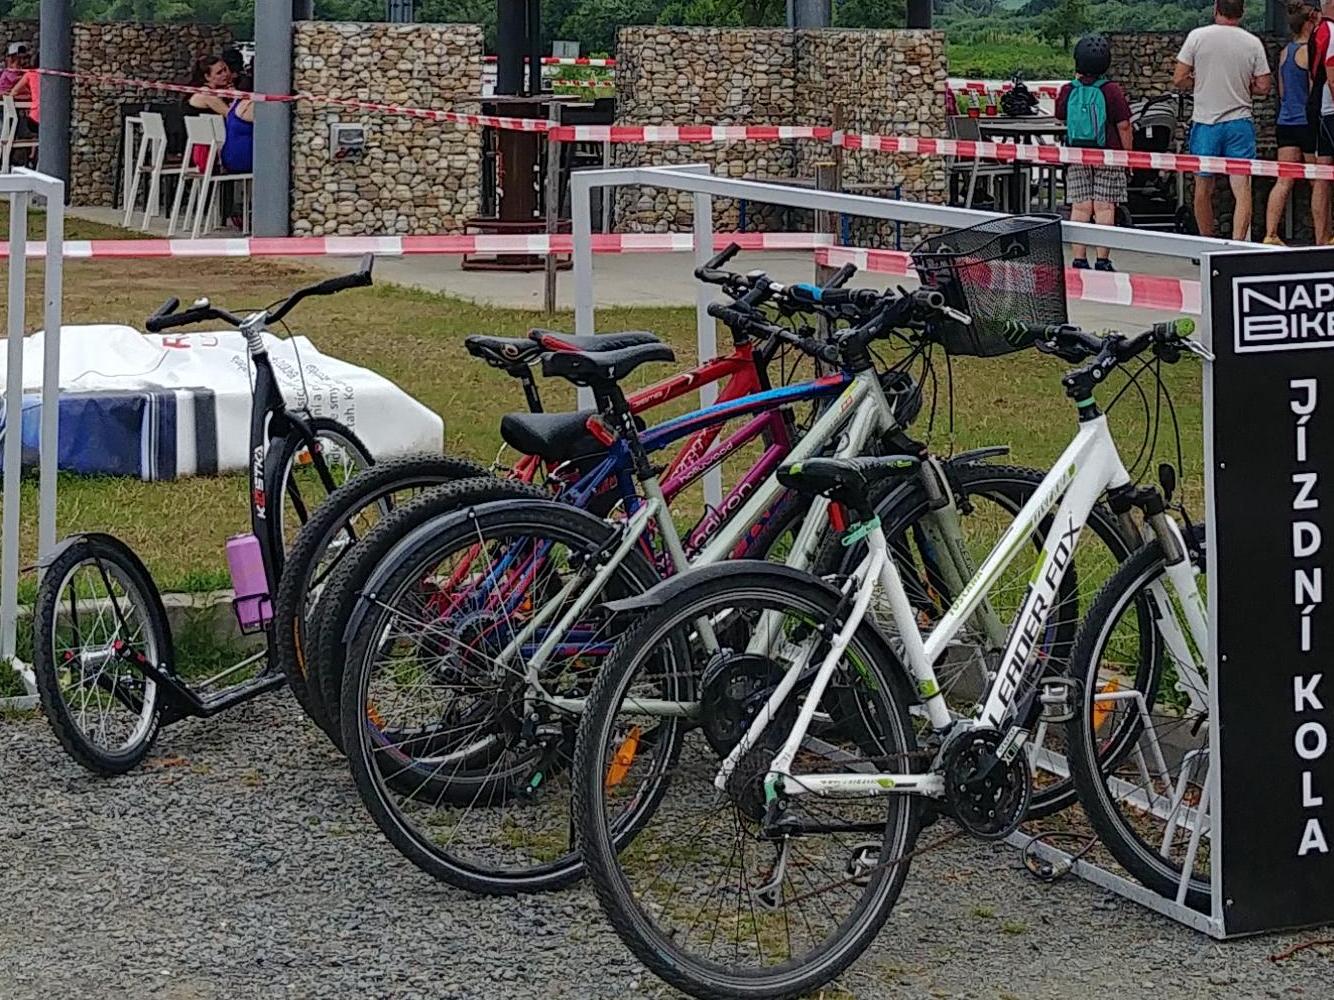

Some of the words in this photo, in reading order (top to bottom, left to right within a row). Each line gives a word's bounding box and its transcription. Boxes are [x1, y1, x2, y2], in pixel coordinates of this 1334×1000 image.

[678, 441, 734, 484] hollywood
[1289, 378, 1323, 652] JÍZDNÍ
[987, 592, 1049, 729] LEADER
[1044, 515, 1083, 592] FOX
[1293, 673, 1329, 856] KOLA
